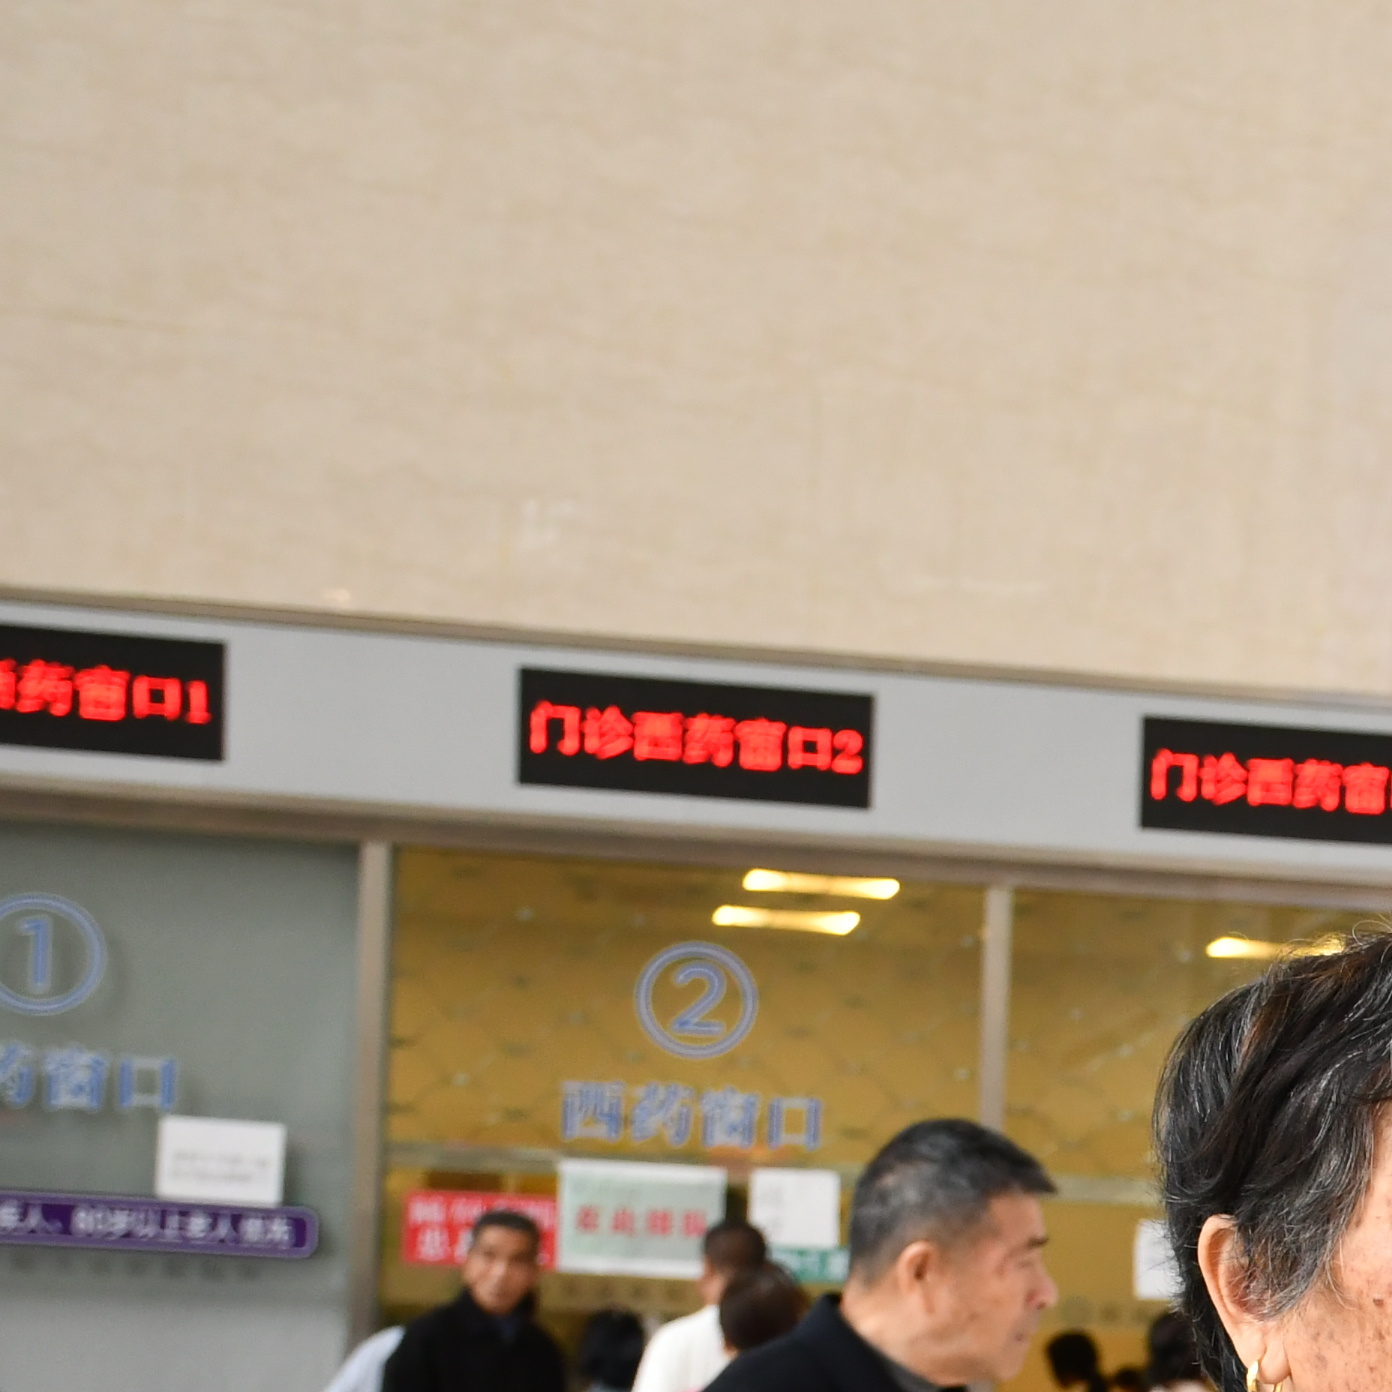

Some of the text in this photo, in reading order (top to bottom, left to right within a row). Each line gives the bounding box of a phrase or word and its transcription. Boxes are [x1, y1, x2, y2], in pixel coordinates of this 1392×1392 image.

[528, 699, 864, 775] 门诊西药窗口2
[559, 1078, 824, 1151] 西药窗口
